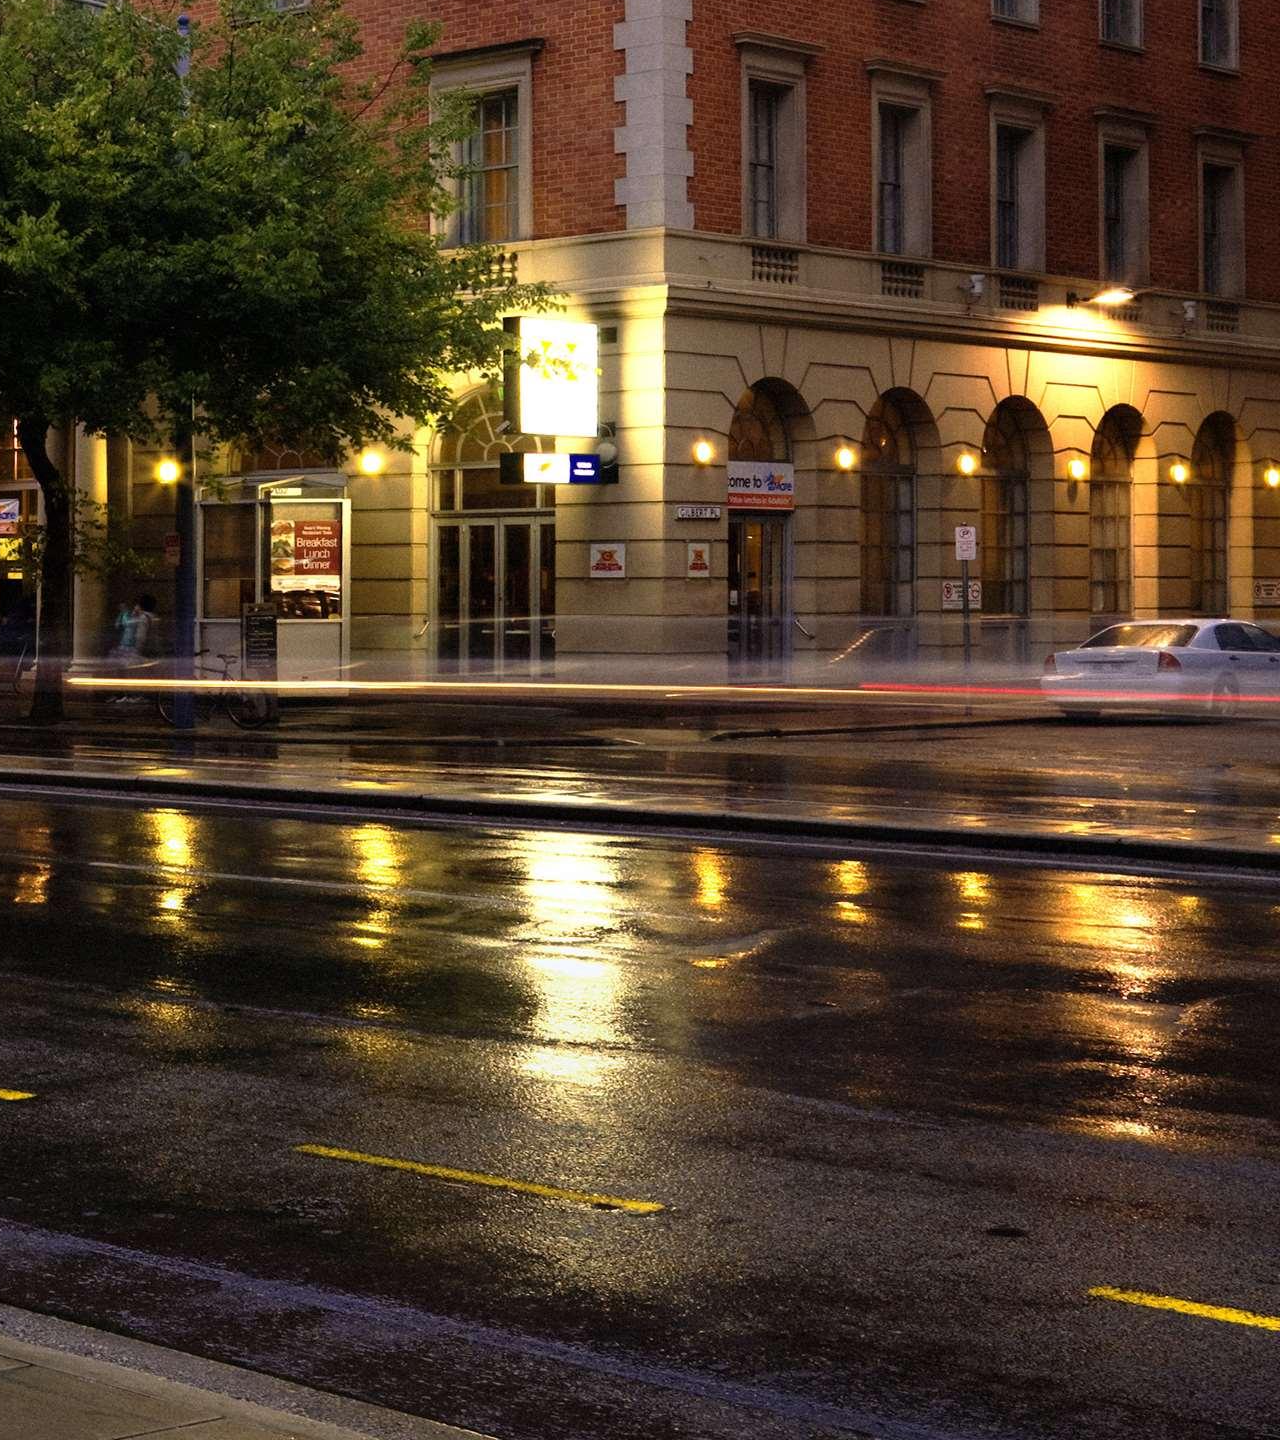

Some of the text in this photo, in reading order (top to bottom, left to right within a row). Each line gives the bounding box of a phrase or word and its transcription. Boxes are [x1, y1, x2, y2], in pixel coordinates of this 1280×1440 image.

[296, 537, 337, 548] Breakfast
[303, 548, 330, 559] Lunch
[303, 560, 331, 570] Dinner
